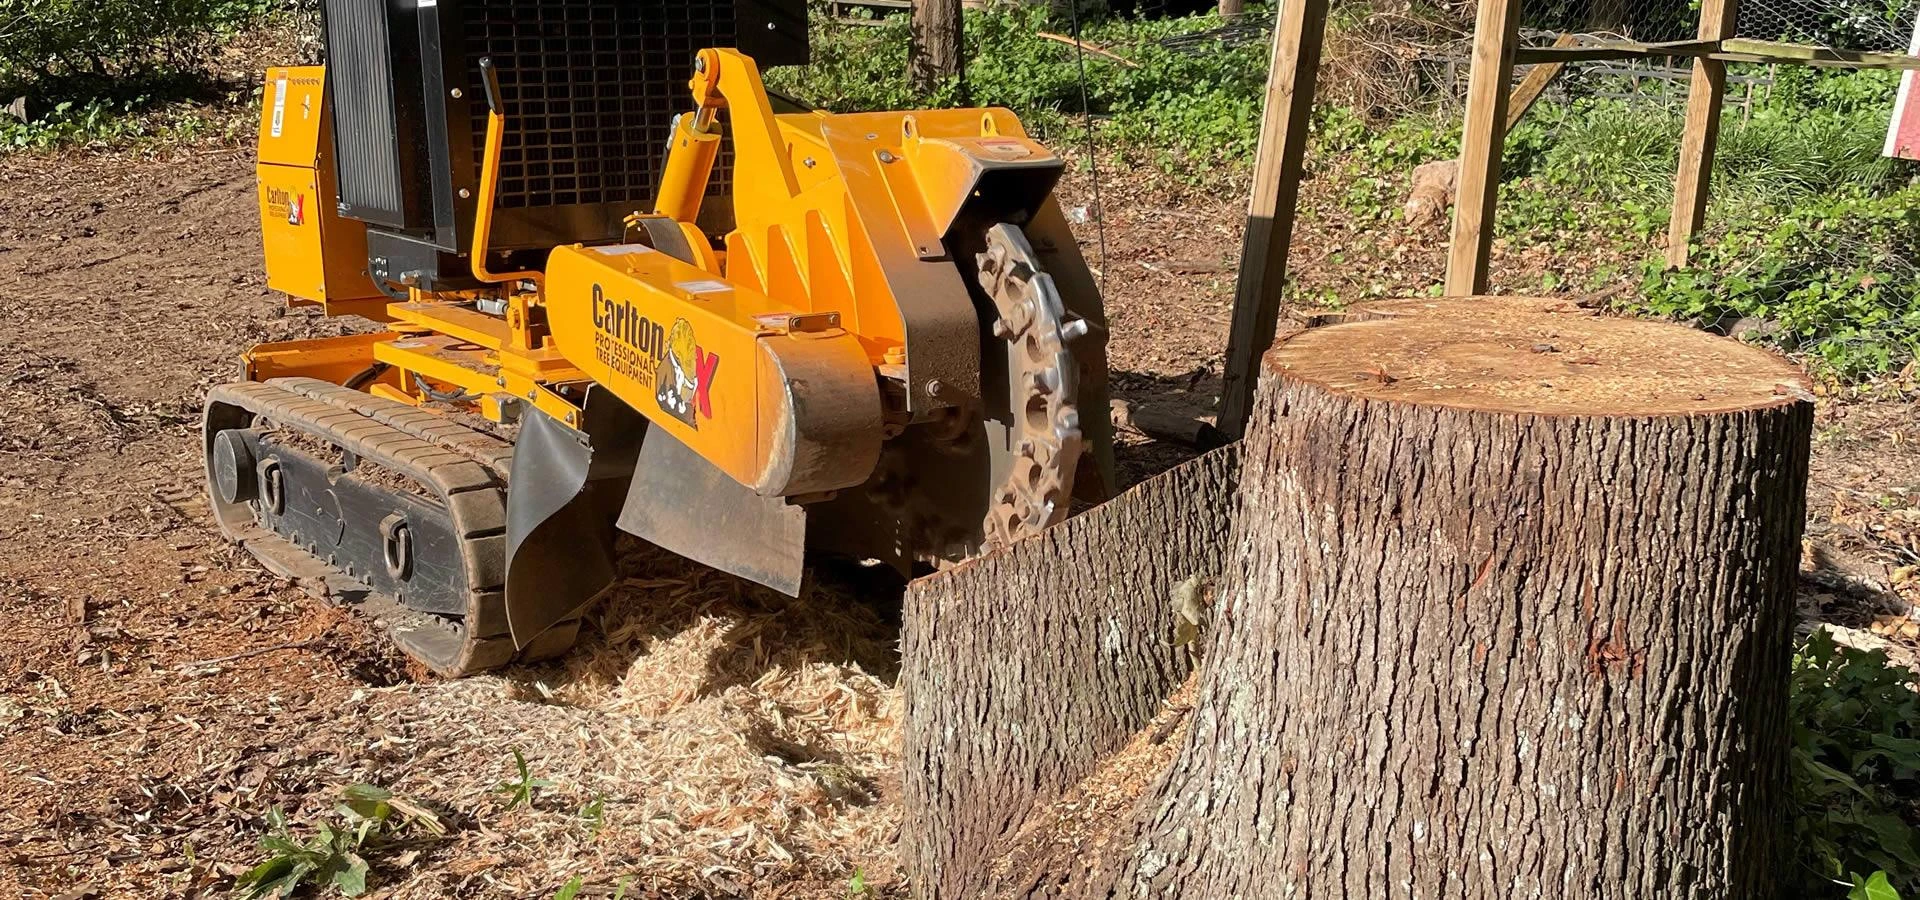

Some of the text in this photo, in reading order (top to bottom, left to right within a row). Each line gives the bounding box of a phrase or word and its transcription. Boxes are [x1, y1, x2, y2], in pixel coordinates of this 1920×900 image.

[267, 185, 290, 206] Carlton
[592, 283, 664, 362] Carlton
[595, 346, 653, 390] TREE EQUIPMENT
